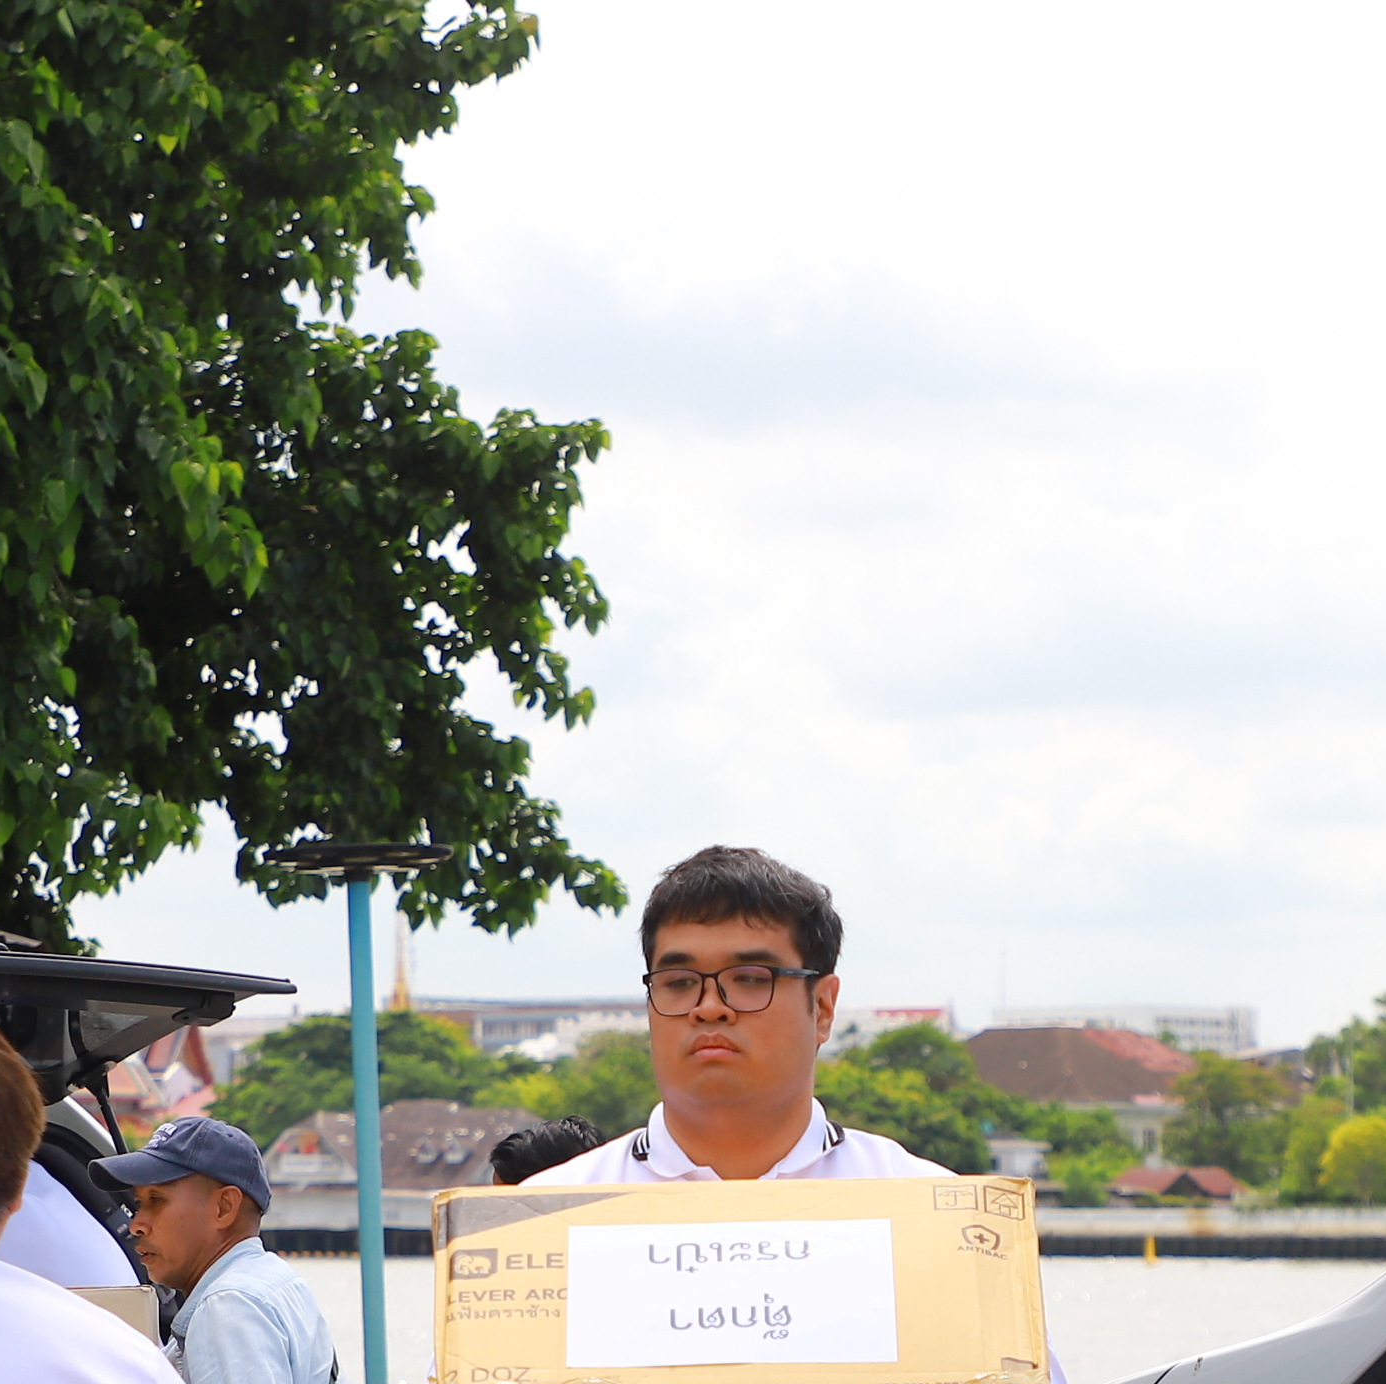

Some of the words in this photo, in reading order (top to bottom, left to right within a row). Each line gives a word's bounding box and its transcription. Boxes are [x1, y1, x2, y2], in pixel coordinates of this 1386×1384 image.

[648, 1240, 811, 1273] กระเป๋า
[957, 1245, 1008, 1260] ANTIBAC
[448, 1289, 516, 1306] LEVER
[670, 1293, 792, 1340] ตุ๊กตา
[471, 1366, 538, 1384] DOZ.
